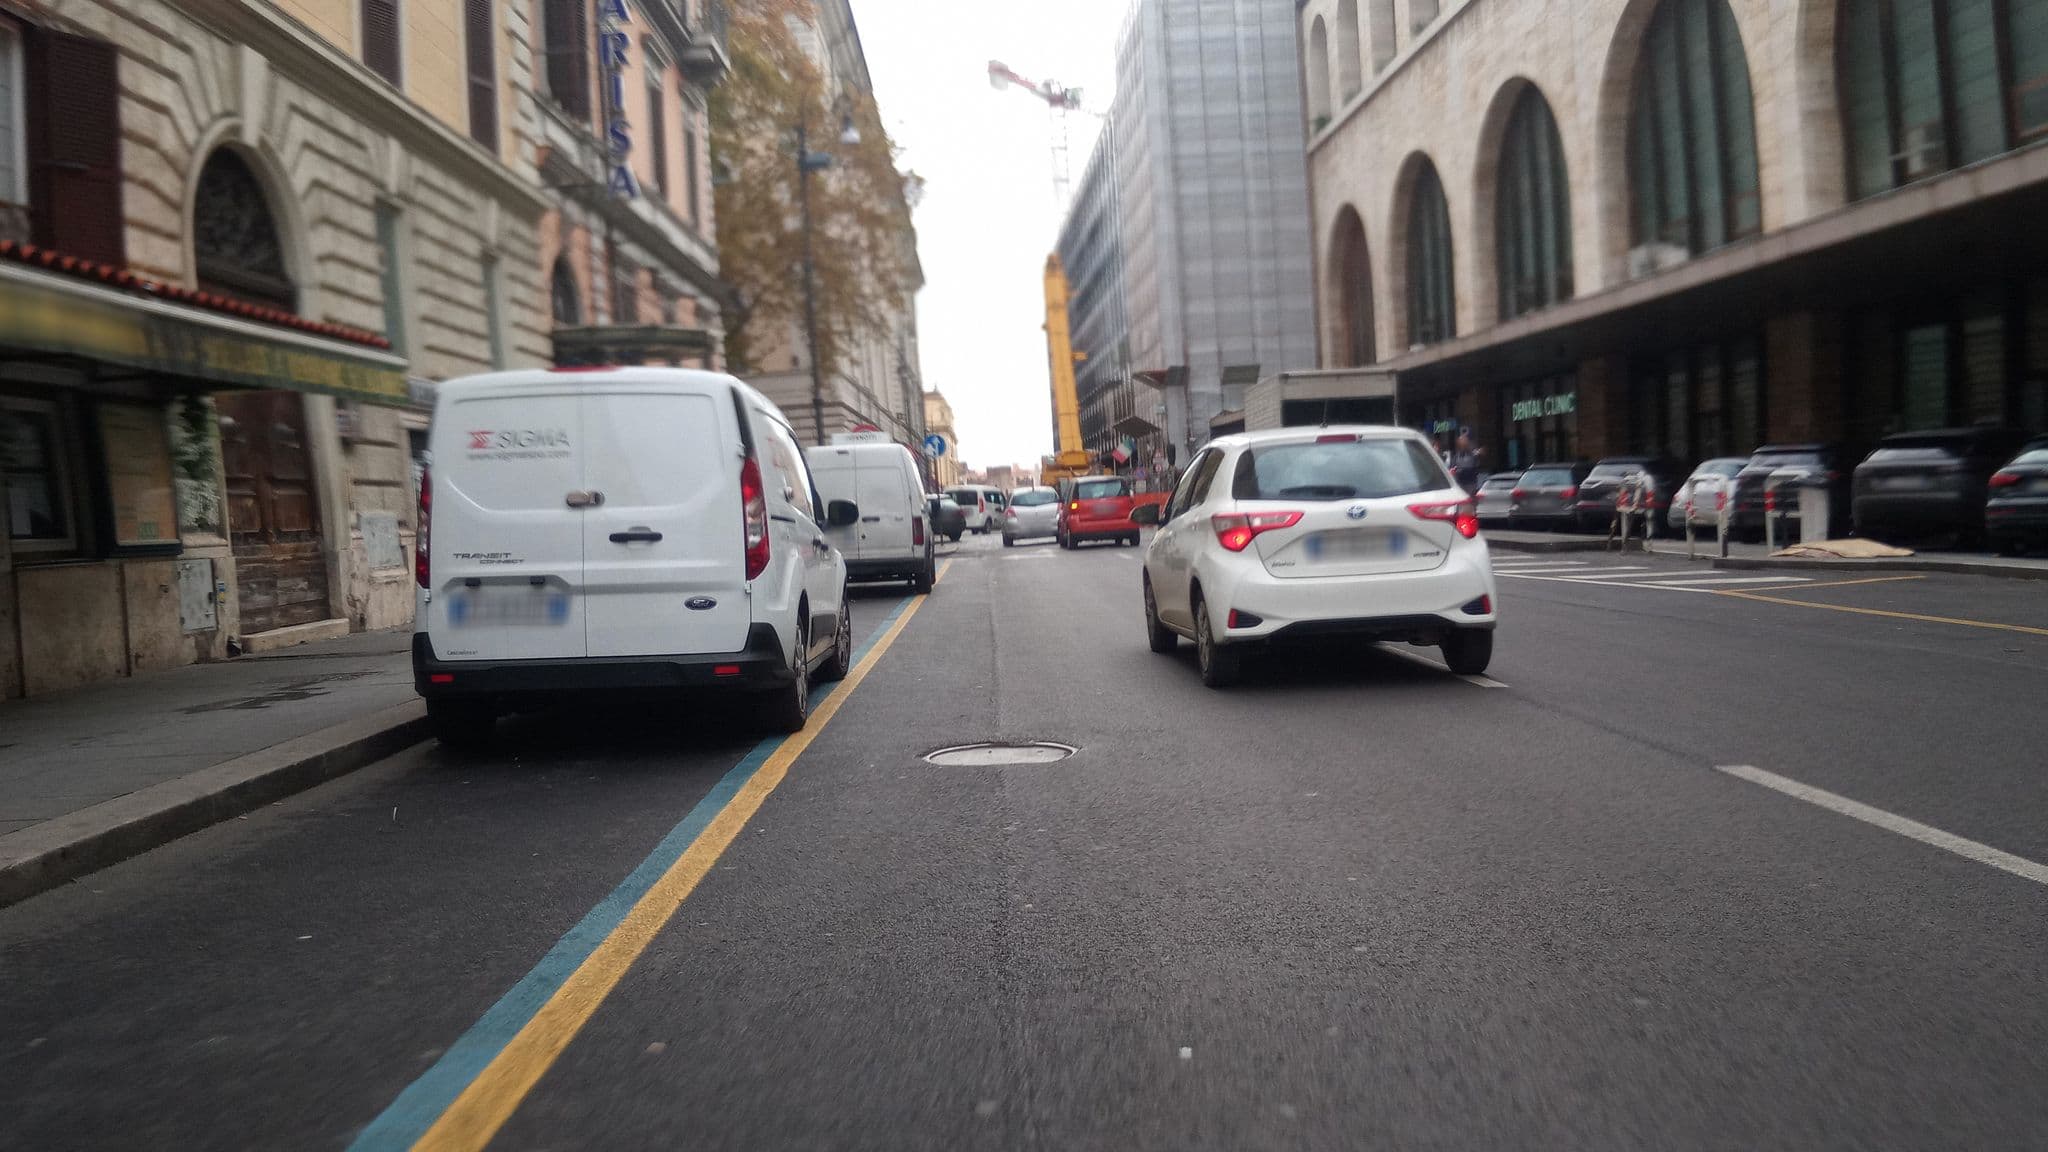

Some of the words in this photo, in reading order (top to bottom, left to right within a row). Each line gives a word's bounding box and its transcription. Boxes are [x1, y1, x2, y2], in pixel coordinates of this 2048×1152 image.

[1512, 400, 1542, 422] DENTAL
[1544, 392, 1575, 416] CLINIC
[497, 429, 570, 448] SIGMA
[452, 551, 512, 560] TRANSIT
